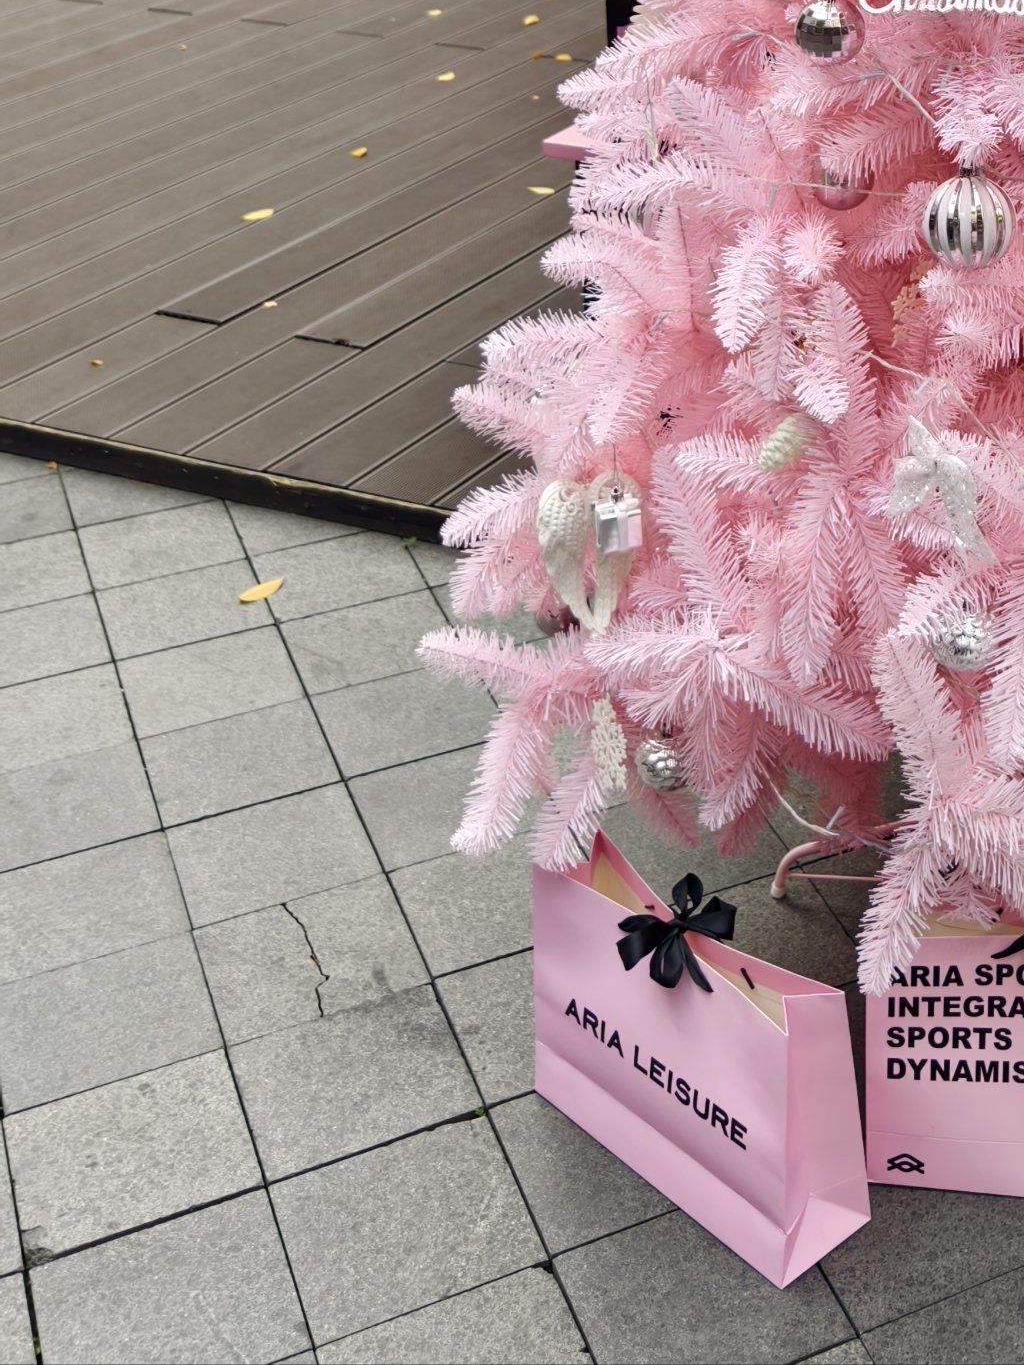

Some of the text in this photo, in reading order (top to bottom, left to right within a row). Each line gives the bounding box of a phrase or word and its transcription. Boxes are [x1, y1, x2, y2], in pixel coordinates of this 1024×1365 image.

[890, 964, 965, 988] ARIA
[886, 1026, 1013, 1051] SPORTS
[564, 997, 749, 1151] ARIA LEISURE
